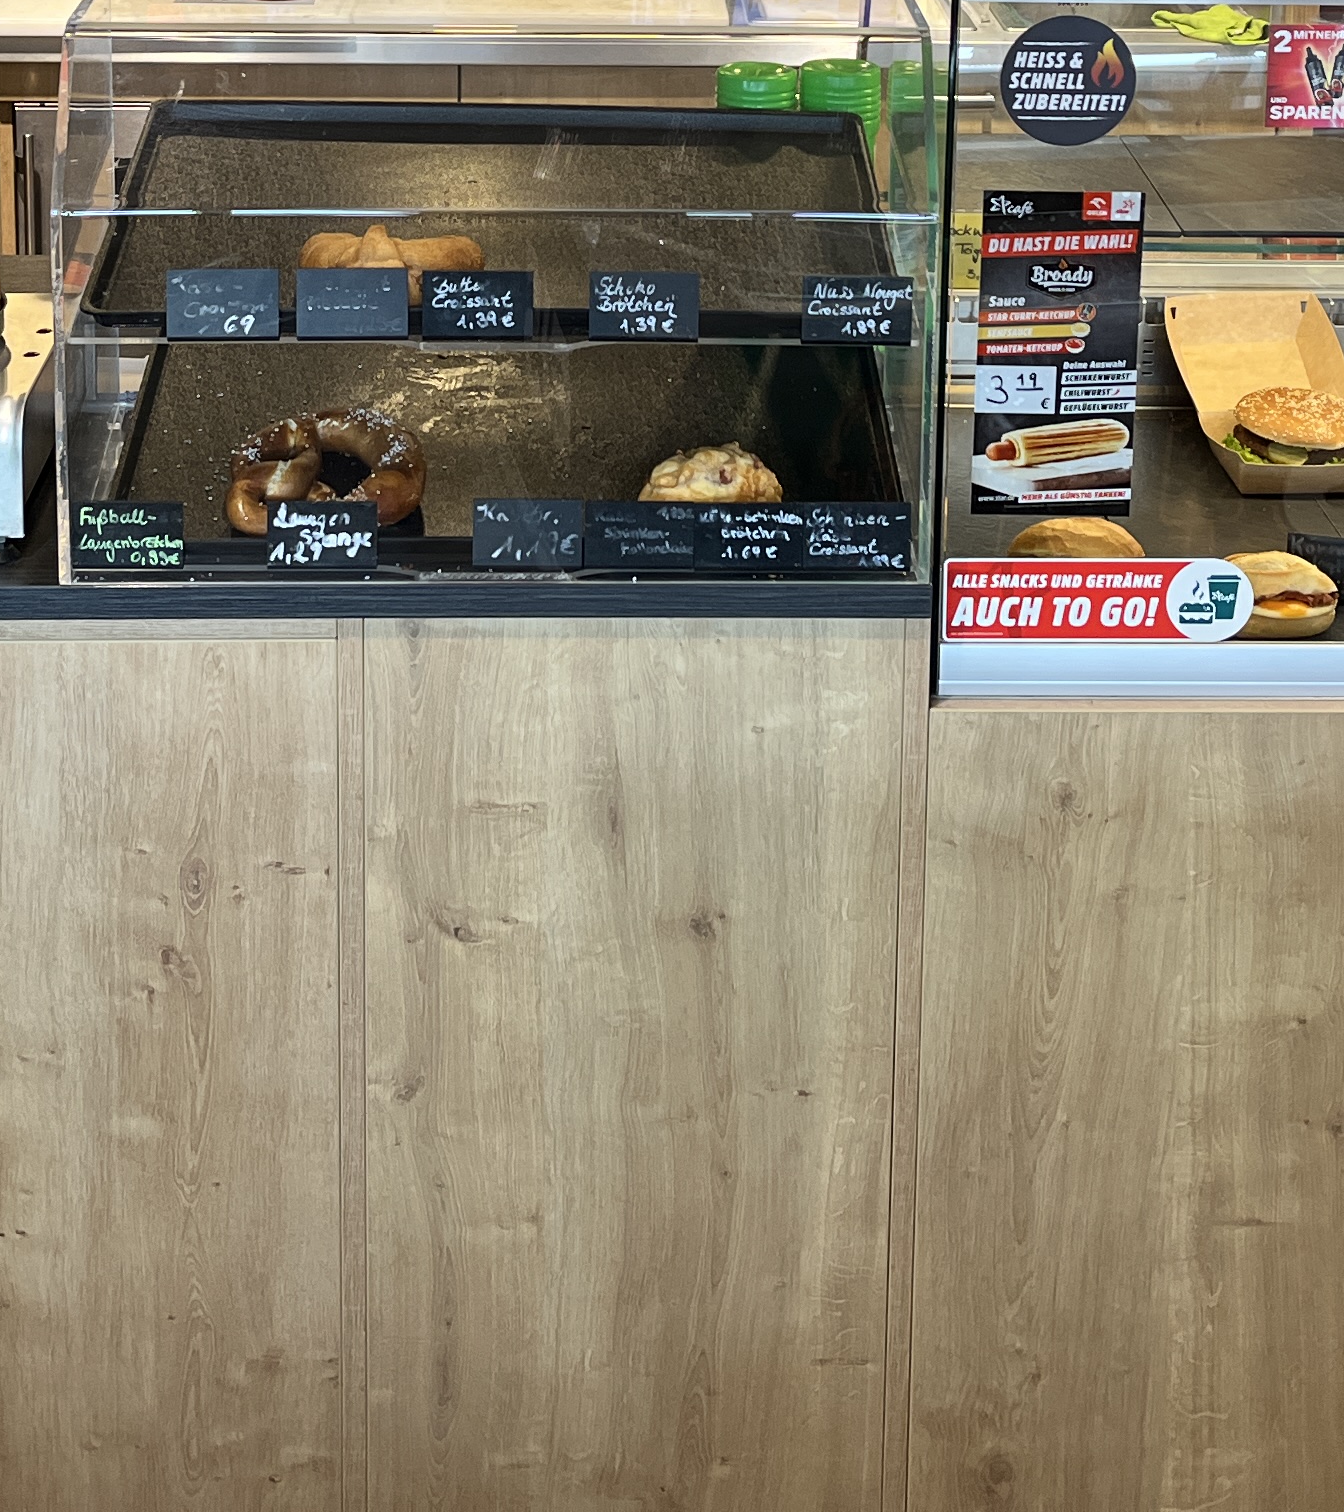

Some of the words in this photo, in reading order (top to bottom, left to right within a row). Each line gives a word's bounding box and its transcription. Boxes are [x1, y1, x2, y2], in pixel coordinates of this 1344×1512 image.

[1274, 30, 1292, 52] 2
[1014, 51, 1065, 68] HEISS
[1070, 52, 1083, 68] &
[1009, 72, 1085, 90] SCHNELL
[1012, 93, 1126, 111] ZUBEREITET!
[1270, 106, 1344, 120] SPAREN
[1007, 201, 1034, 218] café
[988, 239, 1009, 253] DU
[1013, 237, 1052, 252] HAST
[1054, 235, 1080, 250] DIE
[1084, 234, 1133, 250] WAHL!
[1031, 266, 1093, 287] Broady
[432, 293, 513, 309] Croissant
[814, 284, 853, 300] Nuss
[862, 284, 913, 311] Nougat
[989, 296, 1026, 307] Sauce
[808, 301, 883, 317] Croissant
[986, 343, 1063, 354] TOMATEN-KETCHUP
[1063, 361, 1088, 369] Deine
[1089, 360, 1126, 368] Auswahl
[987, 375, 1008, 404] 3
[1016, 372, 1037, 387] 19
[1041, 398, 1050, 409] €
[80, 505, 157, 534] Fußball-
[952, 574, 985, 589] ALLE
[989, 574, 1048, 588] SNACKS
[1051, 574, 1083, 588] UND
[1086, 571, 1164, 588] GETRÄNKE
[951, 597, 1047, 627] AUCH
[1053, 598, 1092, 627] TO
[1100, 597, 1160, 627] GO!
